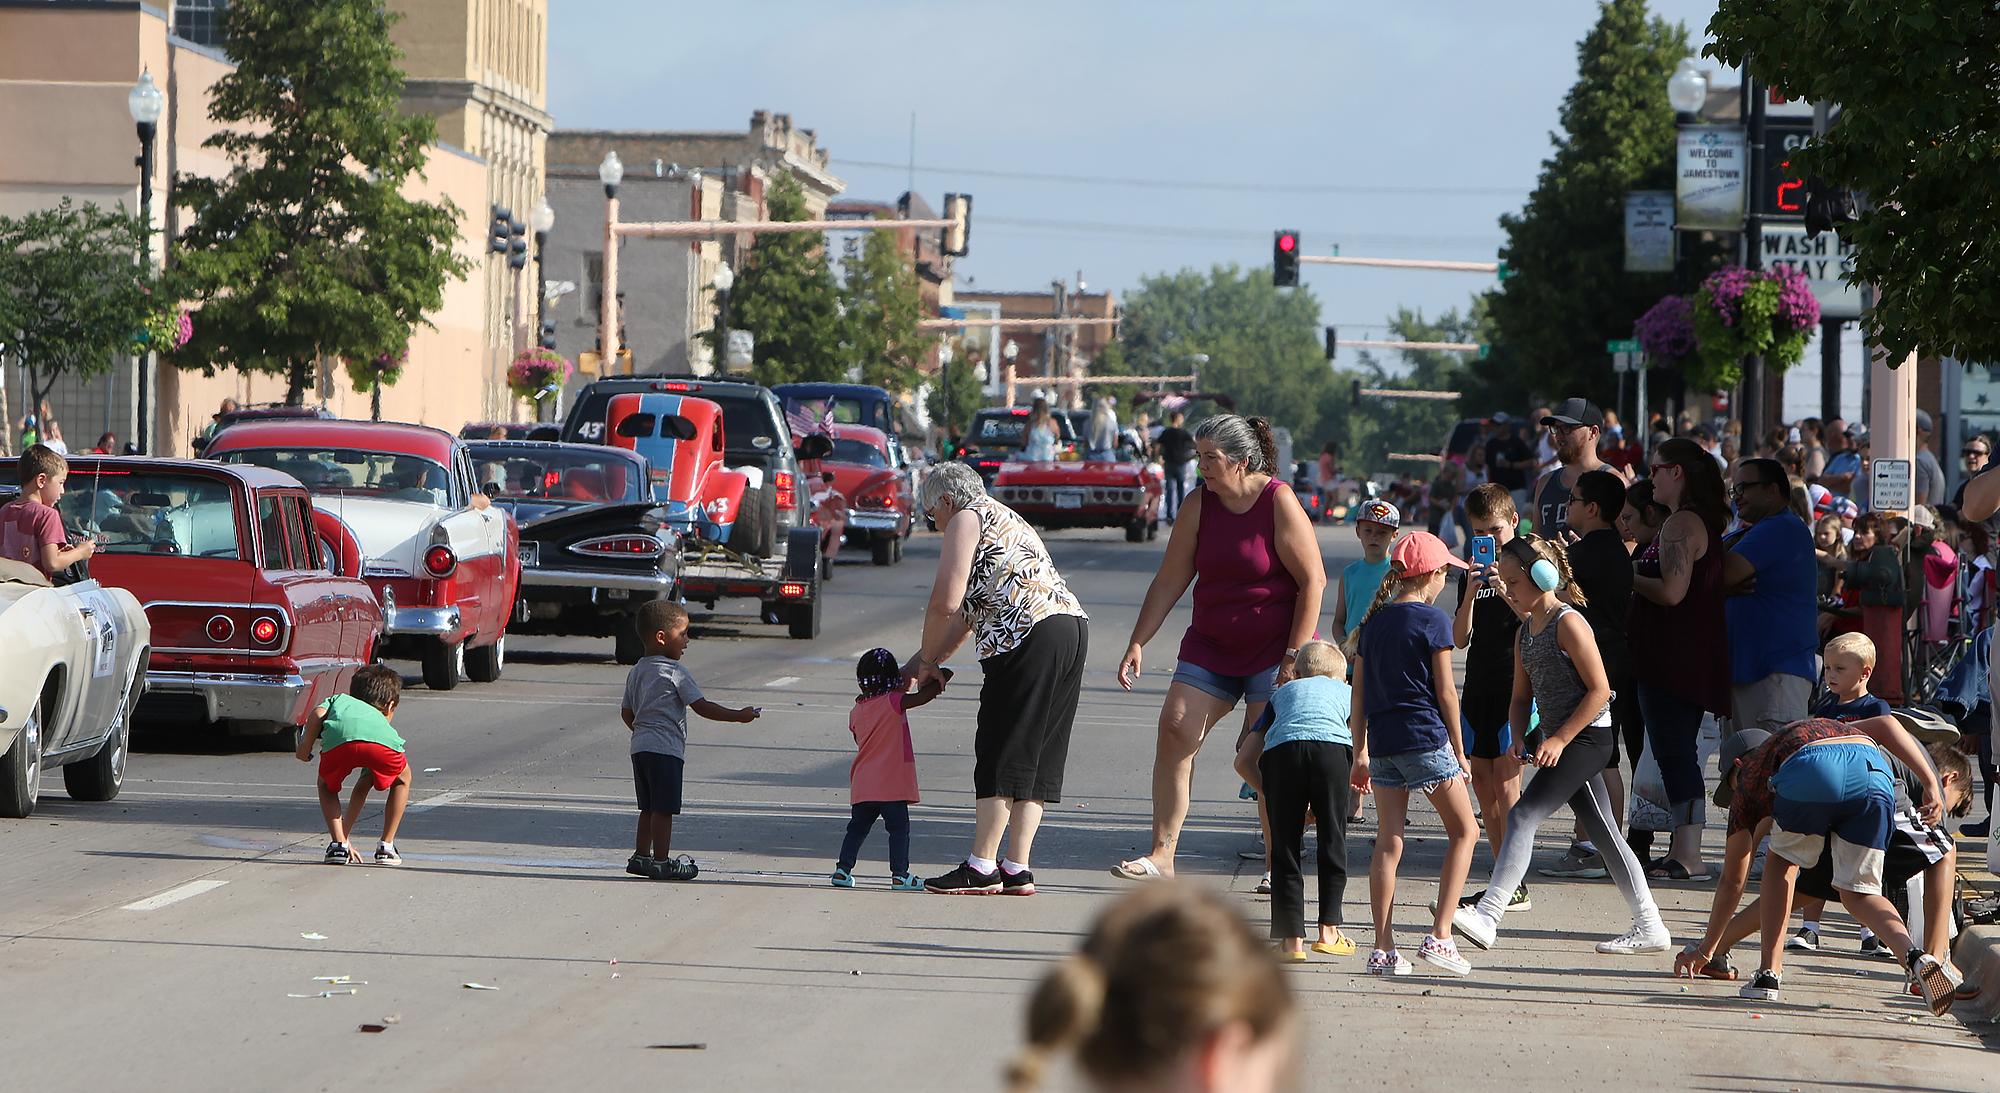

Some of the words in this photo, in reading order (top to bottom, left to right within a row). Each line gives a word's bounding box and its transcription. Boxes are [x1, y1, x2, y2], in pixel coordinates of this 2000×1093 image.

[1689, 149, 1734, 158] WELCOME
[1706, 159, 1717, 168] TO
[1683, 169, 1740, 178] JAMESTOWN
[1765, 235, 1827, 256] WASH
[578, 421, 605, 439] 43
[707, 497, 729, 514] 43
